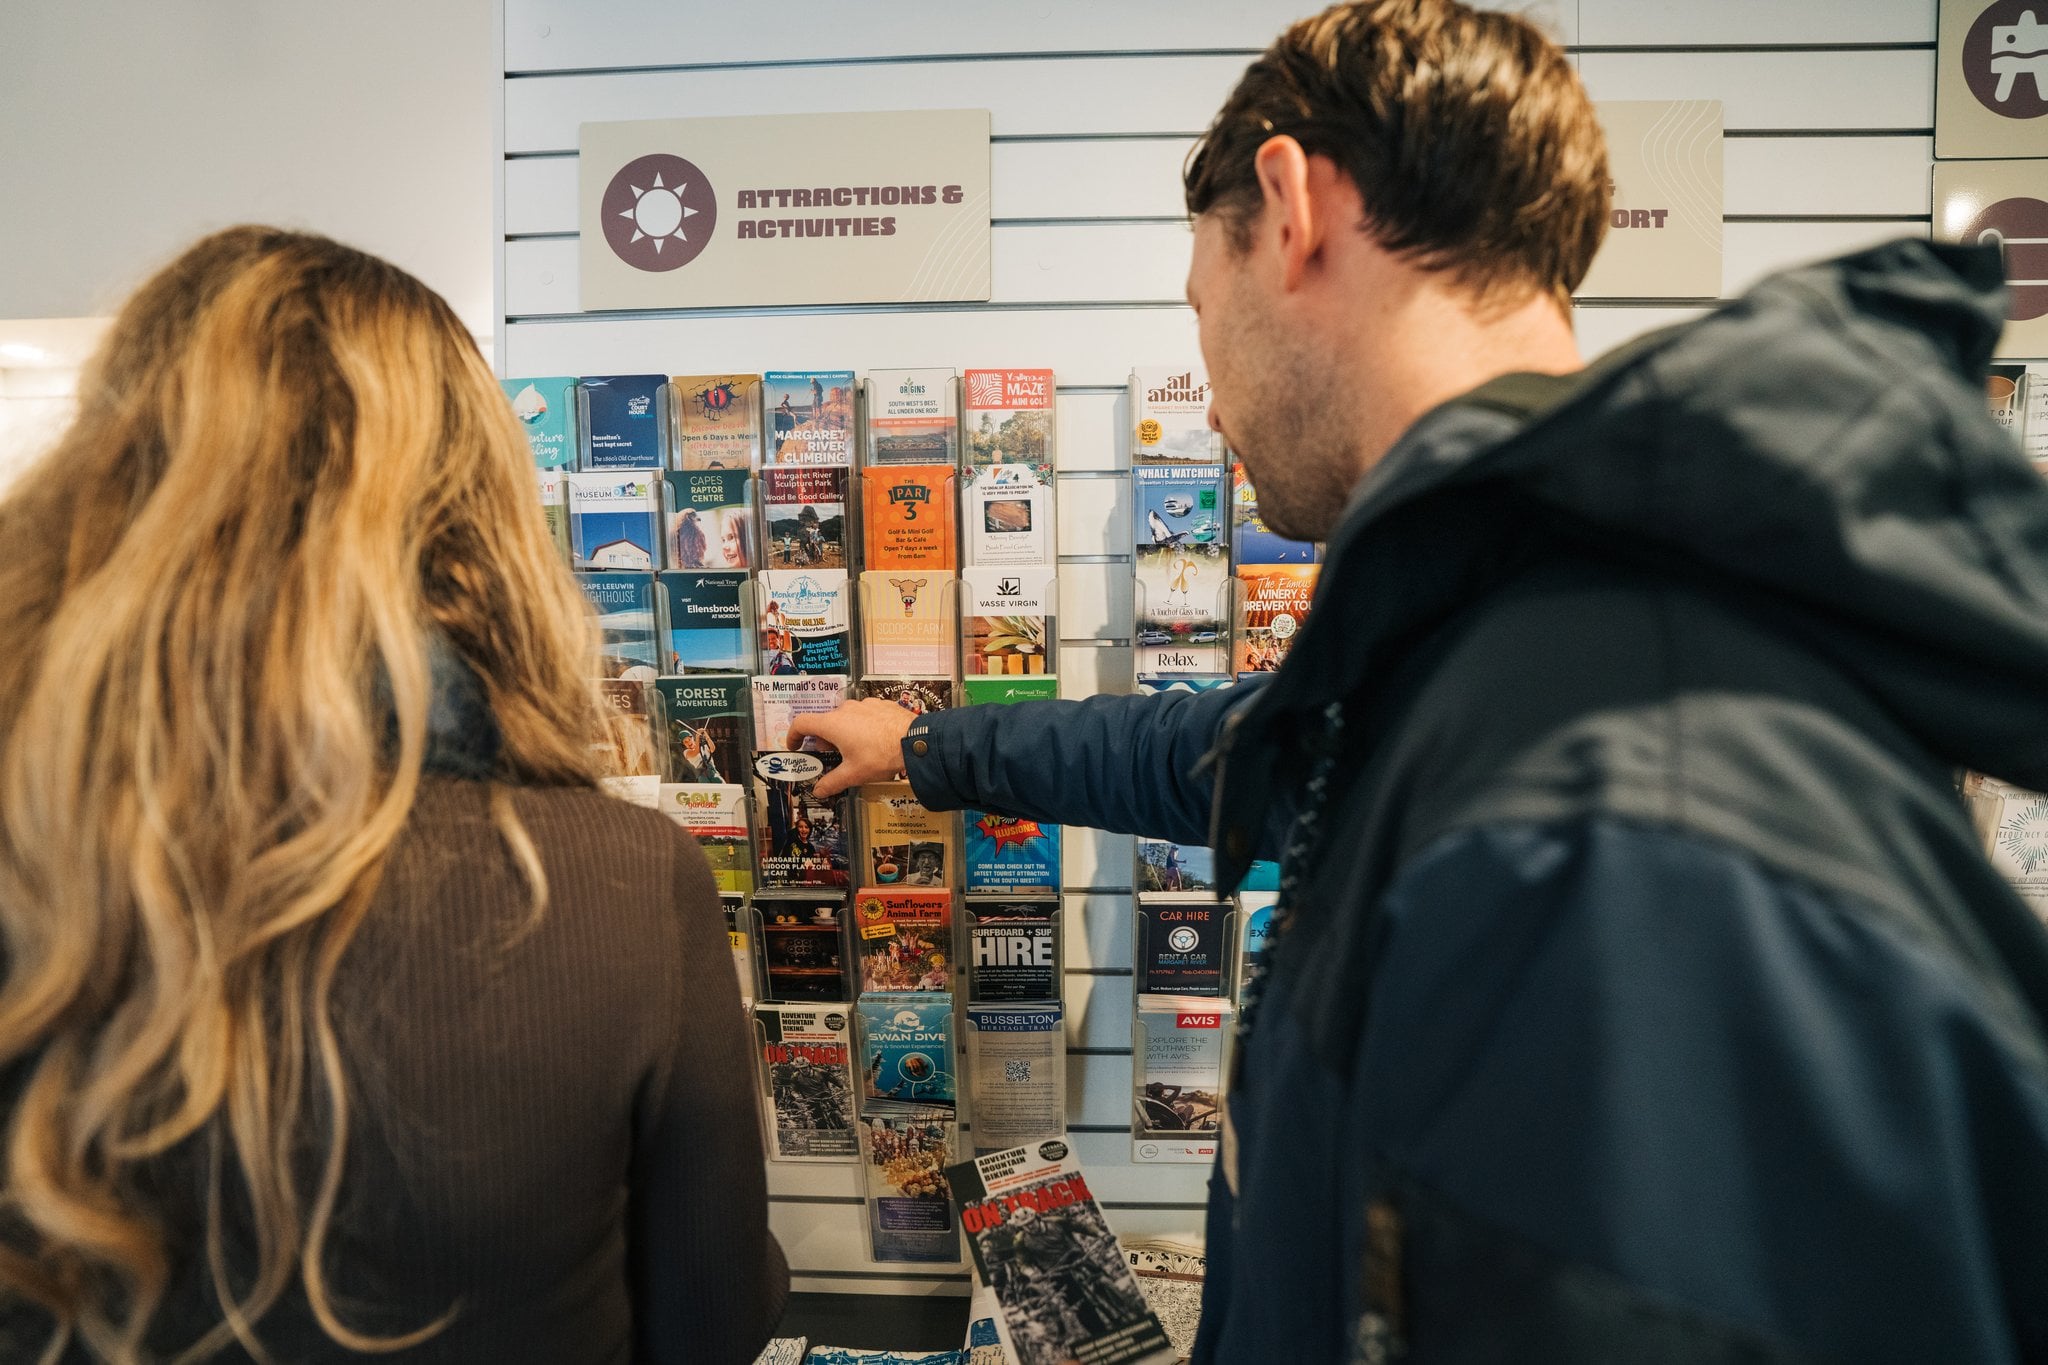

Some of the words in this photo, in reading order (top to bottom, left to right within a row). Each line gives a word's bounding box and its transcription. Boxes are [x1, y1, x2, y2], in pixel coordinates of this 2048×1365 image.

[737, 186, 937, 209] ATTRACTIONS
[941, 185, 964, 204] &
[1610, 209, 1668, 229] ORT
[737, 216, 896, 239] ACTIVITIES
[1166, 372, 1190, 389] all
[1007, 382, 1046, 396] MAZE
[1148, 382, 1211, 402] about
[529, 432, 565, 444] enture
[775, 430, 846, 440] MARGARET
[808, 441, 845, 452] RIVER
[784, 452, 846, 463] CLIMBING
[774, 472, 812, 481] Margaret
[1138, 468, 1170, 479] WHALE
[1171, 468, 1220, 478] WATCHING
[690, 476, 723, 486] CAPES
[820, 493, 844, 501] Gallery
[896, 488, 922, 498] PAR
[904, 502, 916, 520] 3
[1258, 577, 1277, 588] The
[1279, 576, 1313, 589] Famous
[1258, 589, 1298, 600] WINERY
[1300, 589, 1308, 599] &
[687, 604, 740, 614] Ellensbrook
[1244, 600, 1292, 612] BREWERY
[802, 617, 826, 626] ONLINE
[877, 622, 913, 634] SCOOPS
[918, 622, 944, 634] FARM
[802, 638, 840, 649] Adrenaline
[806, 646, 838, 656] pumping
[1158, 652, 1198, 666] Relax.
[754, 682, 770, 691] The
[772, 681, 816, 691] Mermaid's
[818, 681, 839, 690] Cave
[676, 688, 726, 699] FOREST
[884, 684, 910, 696] Picnic
[913, 683, 946, 711] Adventu
[783, 758, 807, 768] Ninjas
[796, 765, 818, 774] Ocean
[676, 792, 721, 806] GOLF
[995, 823, 1036, 838] ILLUSIONS
[886, 900, 942, 908] Sunflowers
[1160, 911, 1182, 920] CAR
[1186, 911, 1210, 920] HIRE
[972, 928, 1024, 936] SURFBOARD
[1035, 928, 1052, 936] SUP
[972, 937, 1054, 966] HIRE
[981, 1015, 1054, 1024] BUSSELTON
[1182, 1016, 1214, 1024] AVIS
[764, 1045, 788, 1064] ON
[790, 1046, 848, 1064] TRACK
[979, 1148, 1026, 1166] ADVENTURE
[982, 1156, 1026, 1174] MOUNTAIN
[984, 1168, 1015, 1182] BIKING
[962, 1204, 1002, 1233] ON
[1003, 1176, 1092, 1214] TRACK
